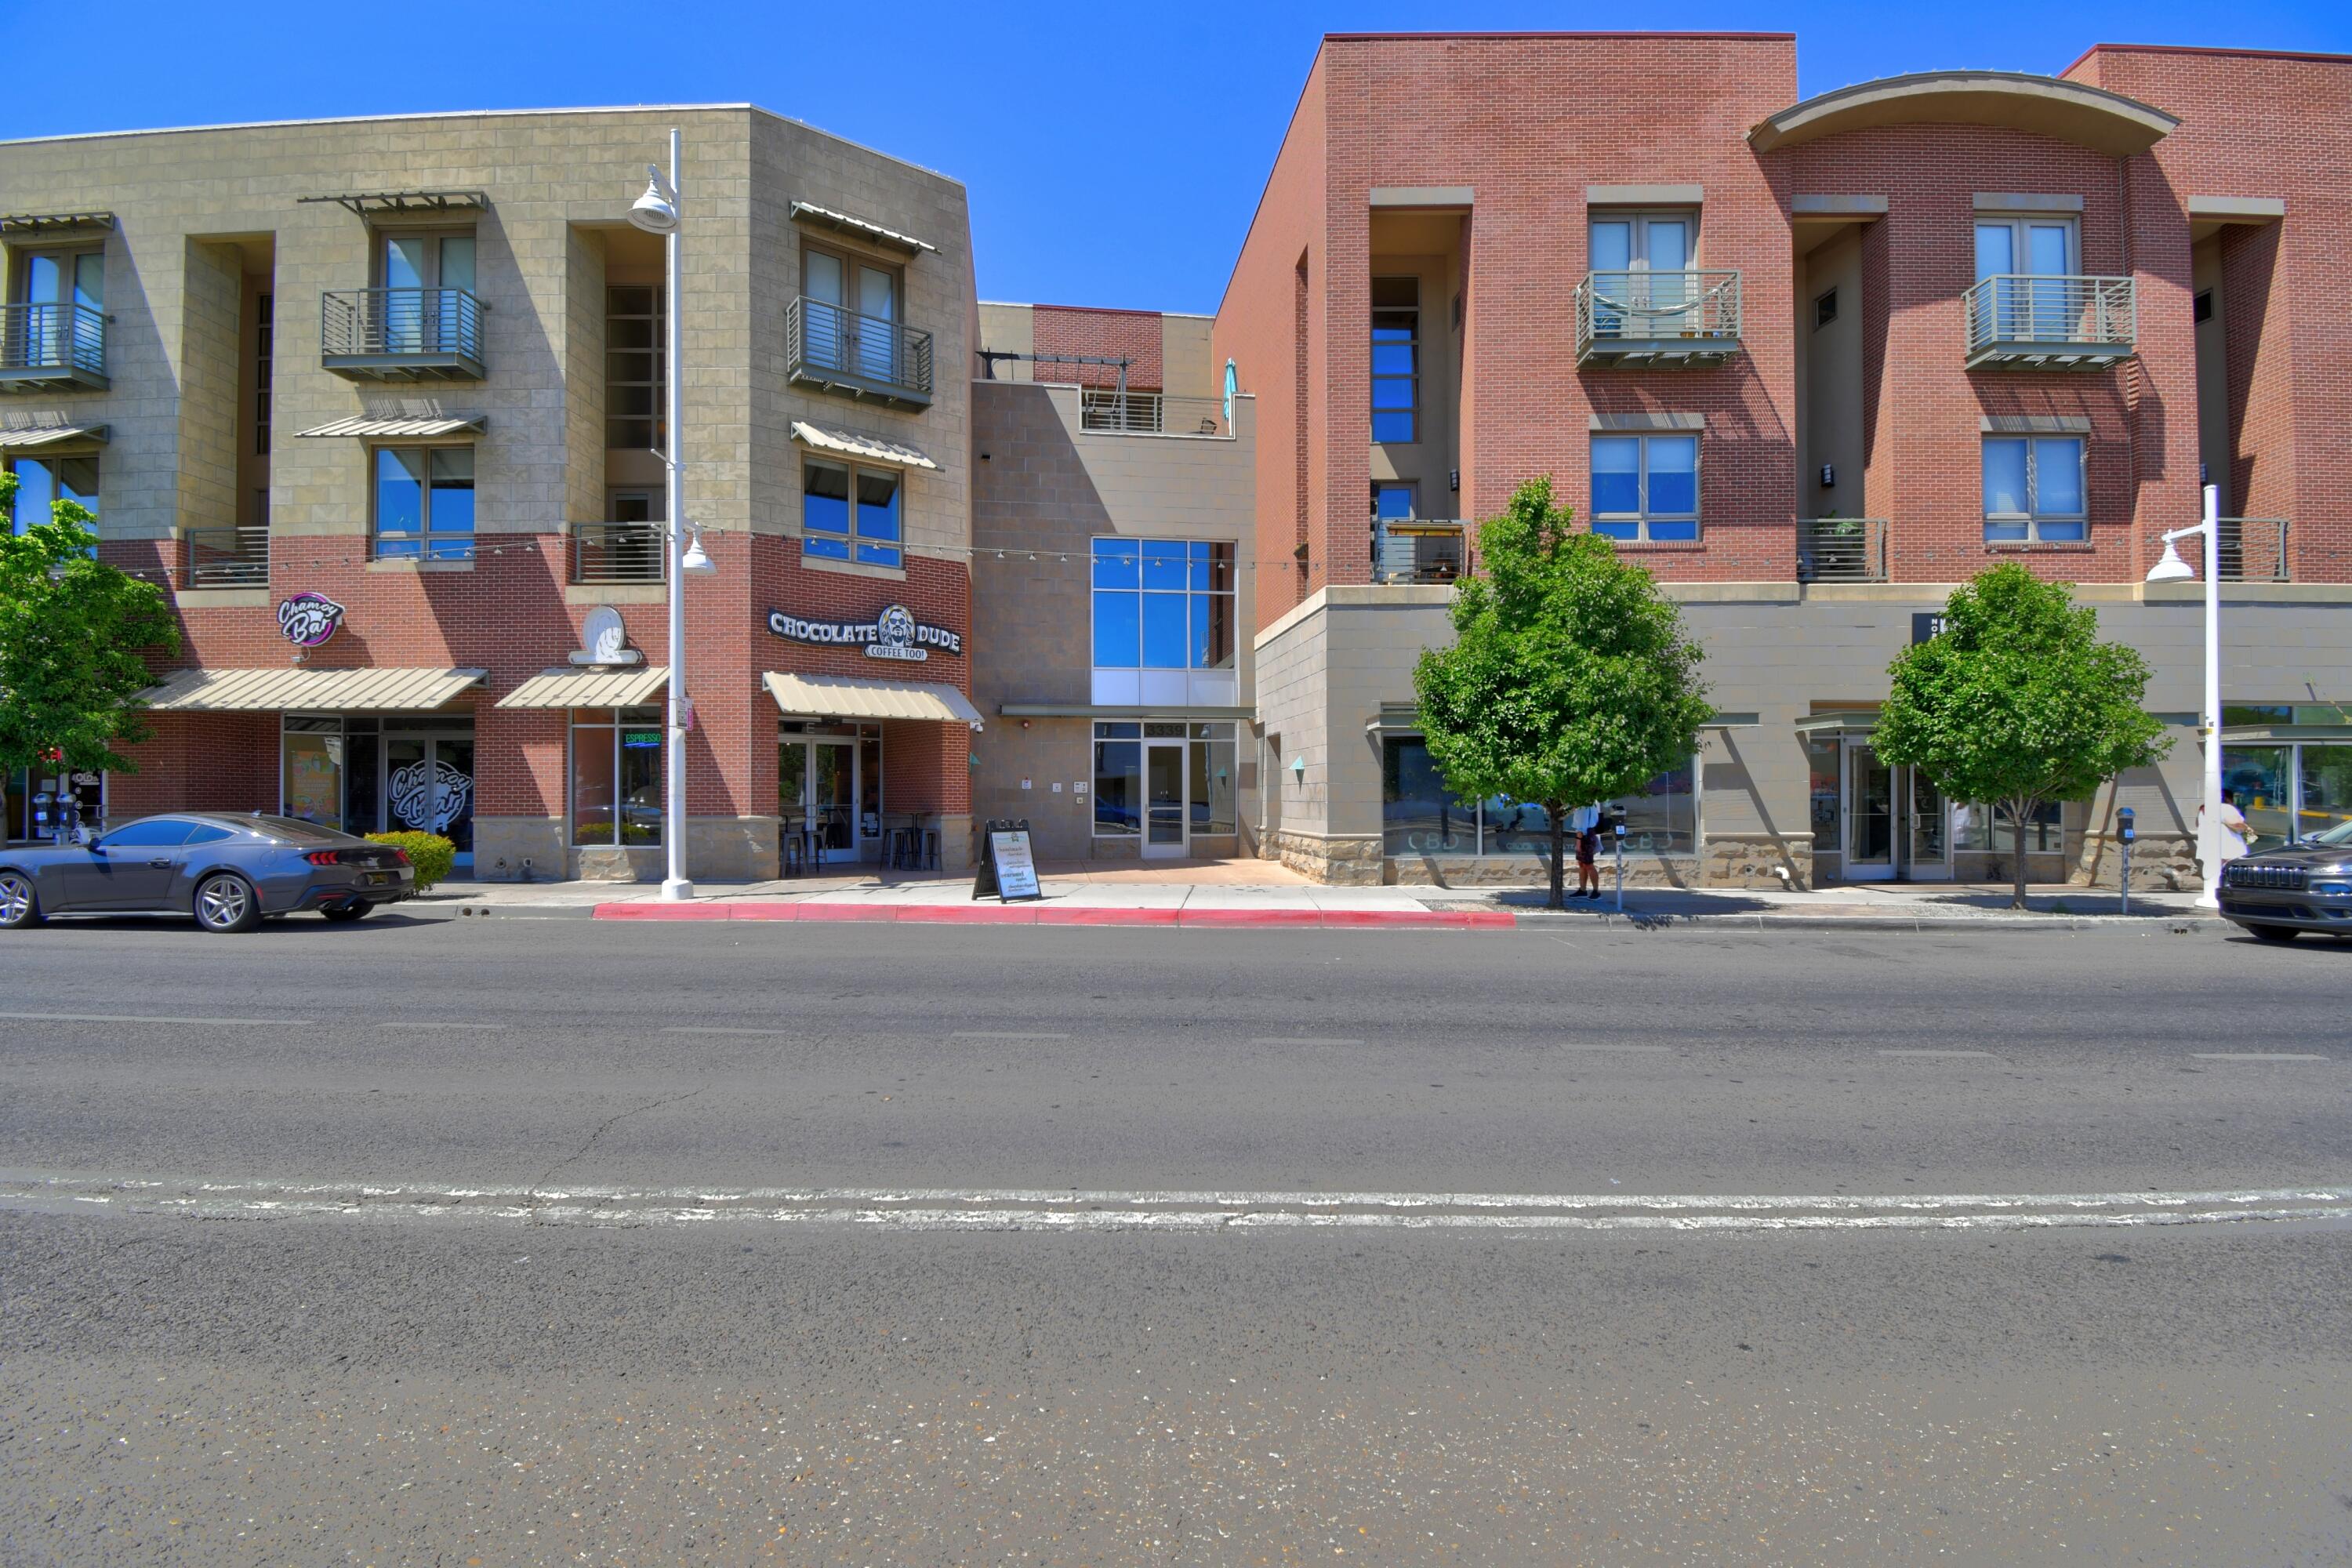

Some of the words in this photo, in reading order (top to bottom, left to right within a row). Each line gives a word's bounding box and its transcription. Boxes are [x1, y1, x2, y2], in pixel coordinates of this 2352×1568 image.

[278, 601, 338, 624] Chamoy
[283, 612, 331, 643] Bar
[771, 612, 877, 642] CHOCOLATE
[916, 626, 960, 652] DUDE
[871, 647, 902, 657] COFFEE
[905, 649, 924, 659] TOO!
[806, 722, 815, 734] E
[1147, 724, 1182, 735] 3339
[626, 733, 661, 743] ESPRESSO
[1408, 832, 1460, 850] CBD
